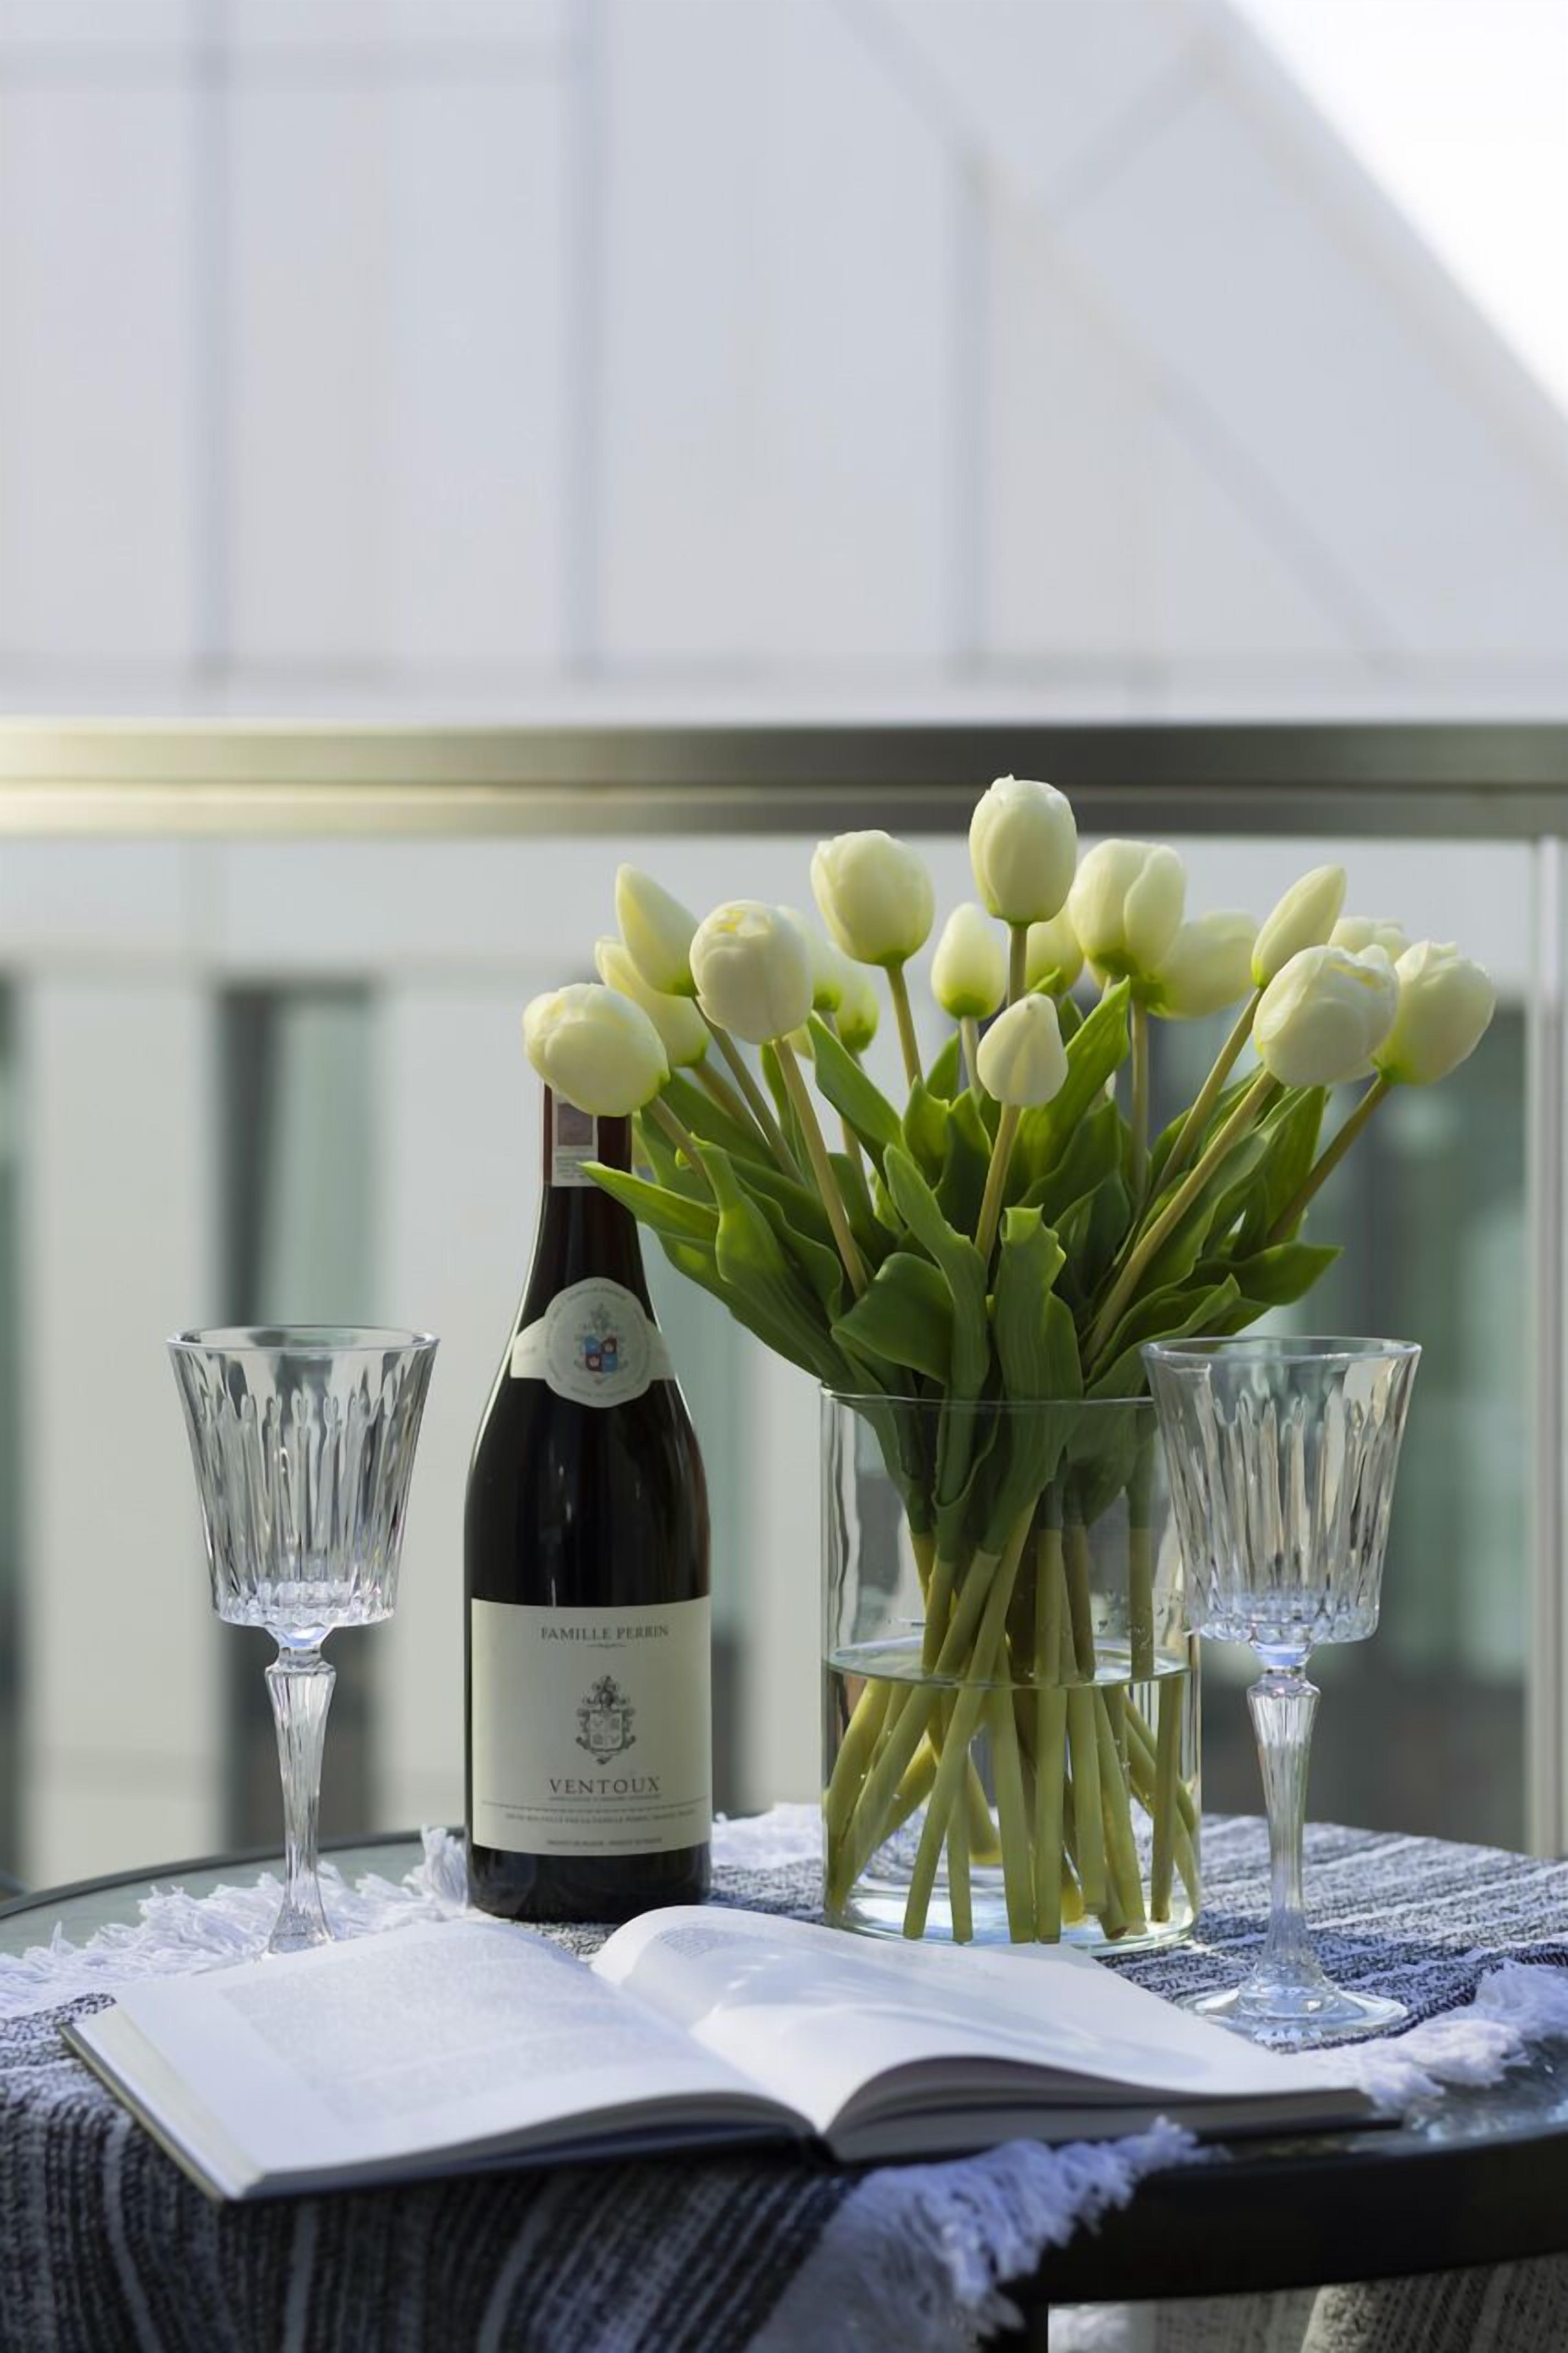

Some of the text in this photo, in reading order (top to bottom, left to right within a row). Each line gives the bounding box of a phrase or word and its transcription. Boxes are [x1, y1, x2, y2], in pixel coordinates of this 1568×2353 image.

[541, 1626, 669, 1640] FAMILLE PERRIN
[549, 1776, 660, 1794] VENTOUX
